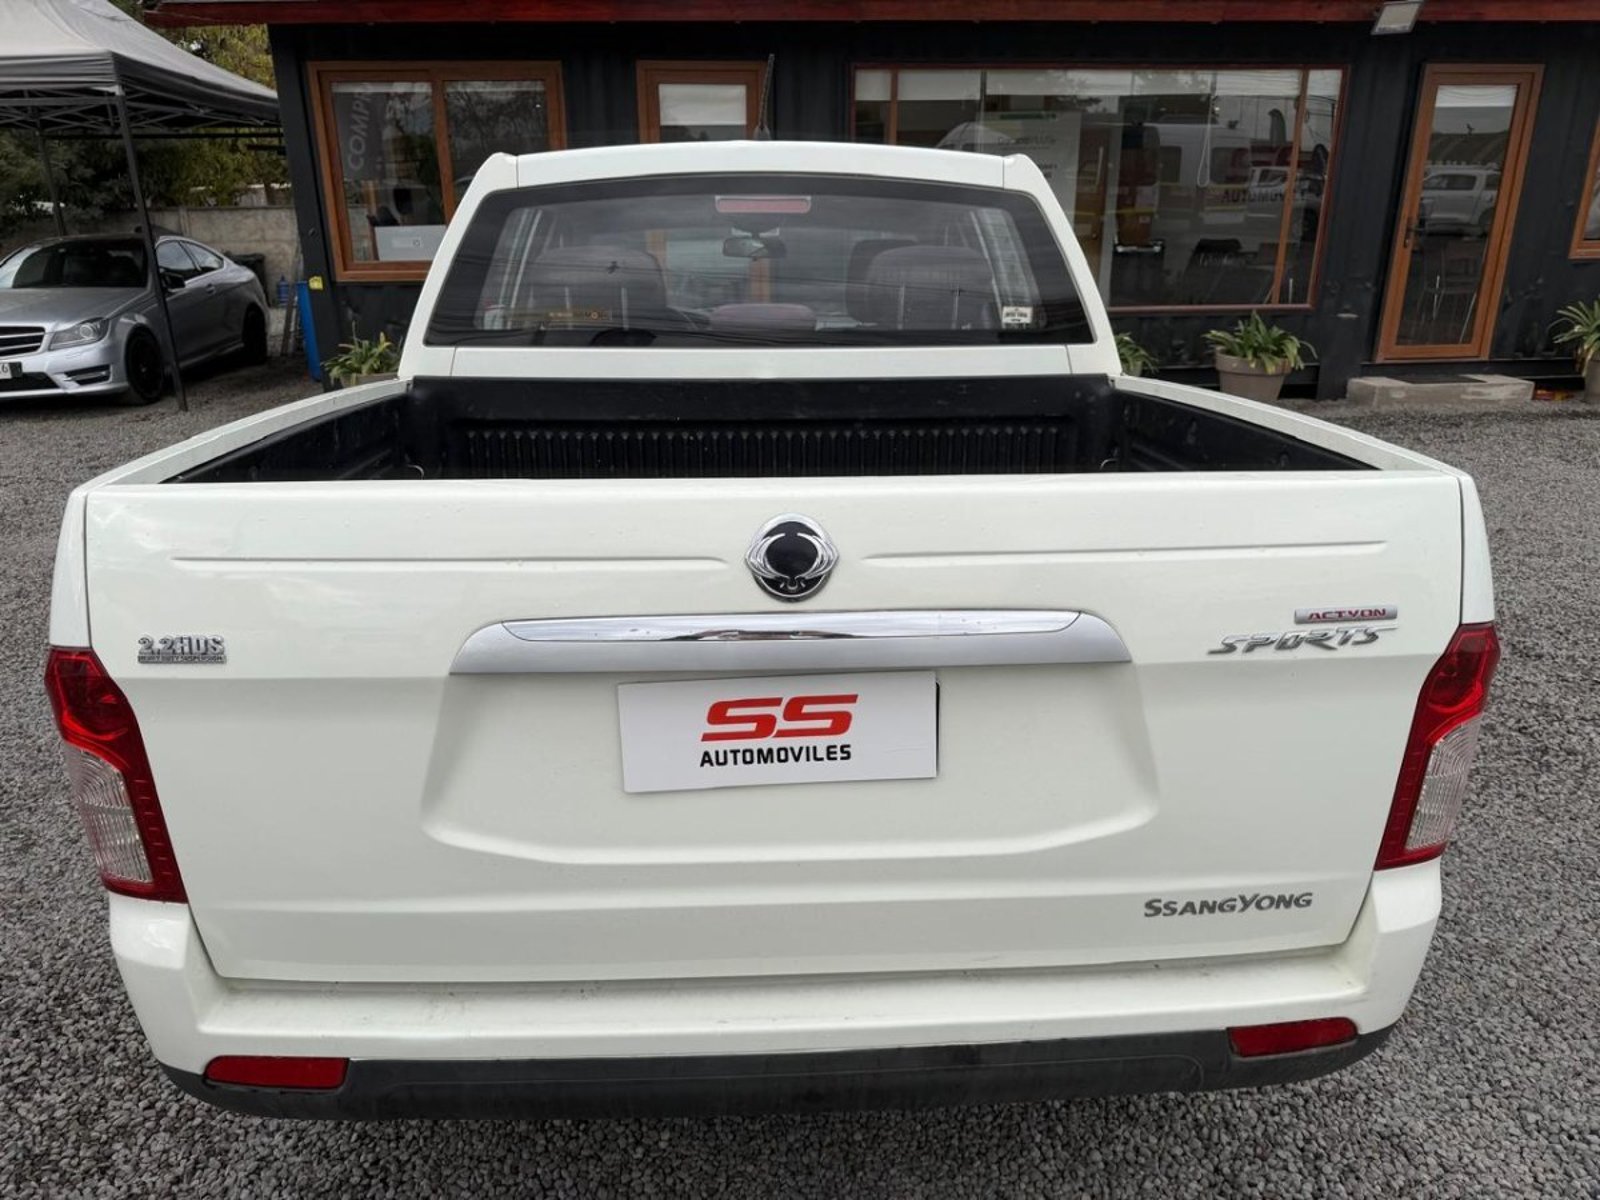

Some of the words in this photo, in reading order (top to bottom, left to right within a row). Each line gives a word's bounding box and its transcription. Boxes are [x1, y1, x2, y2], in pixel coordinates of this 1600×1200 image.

[1307, 608, 1387, 621] ACTYON
[1207, 624, 1398, 655] SPORTS
[700, 694, 859, 742] SS
[699, 743, 852, 768] AUTOMOVILES
